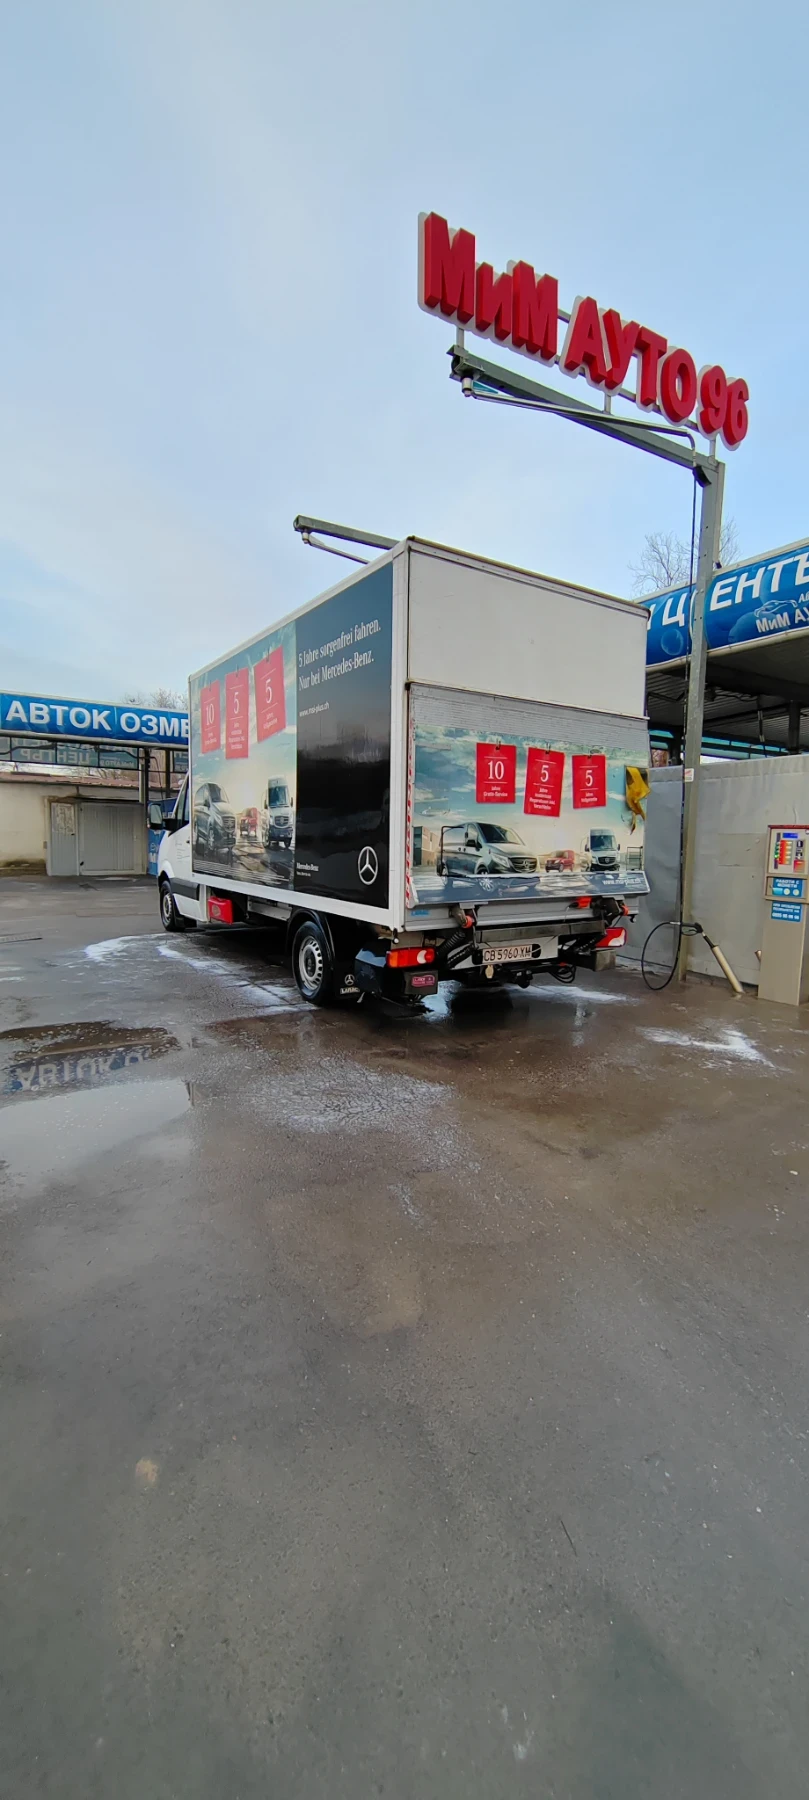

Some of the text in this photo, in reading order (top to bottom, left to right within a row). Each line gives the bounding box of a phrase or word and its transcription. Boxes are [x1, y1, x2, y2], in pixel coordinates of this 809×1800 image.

[423, 211, 749, 447] МиМ АУТО 96
[756, 612, 791, 633] МиМ
[298, 619, 381, 668] 5 Jahre sorgenfrei fahren.
[298, 650, 374, 691] Nur bei Mercedes-Benz.
[233, 691, 240, 714] 5
[265, 679, 272, 704] 5
[205, 703, 214, 726] 10
[487, 760, 505, 780] 10
[540, 764, 549, 782] 5
[585, 769, 593, 787] 5
[497, 947, 519, 960] 5960
